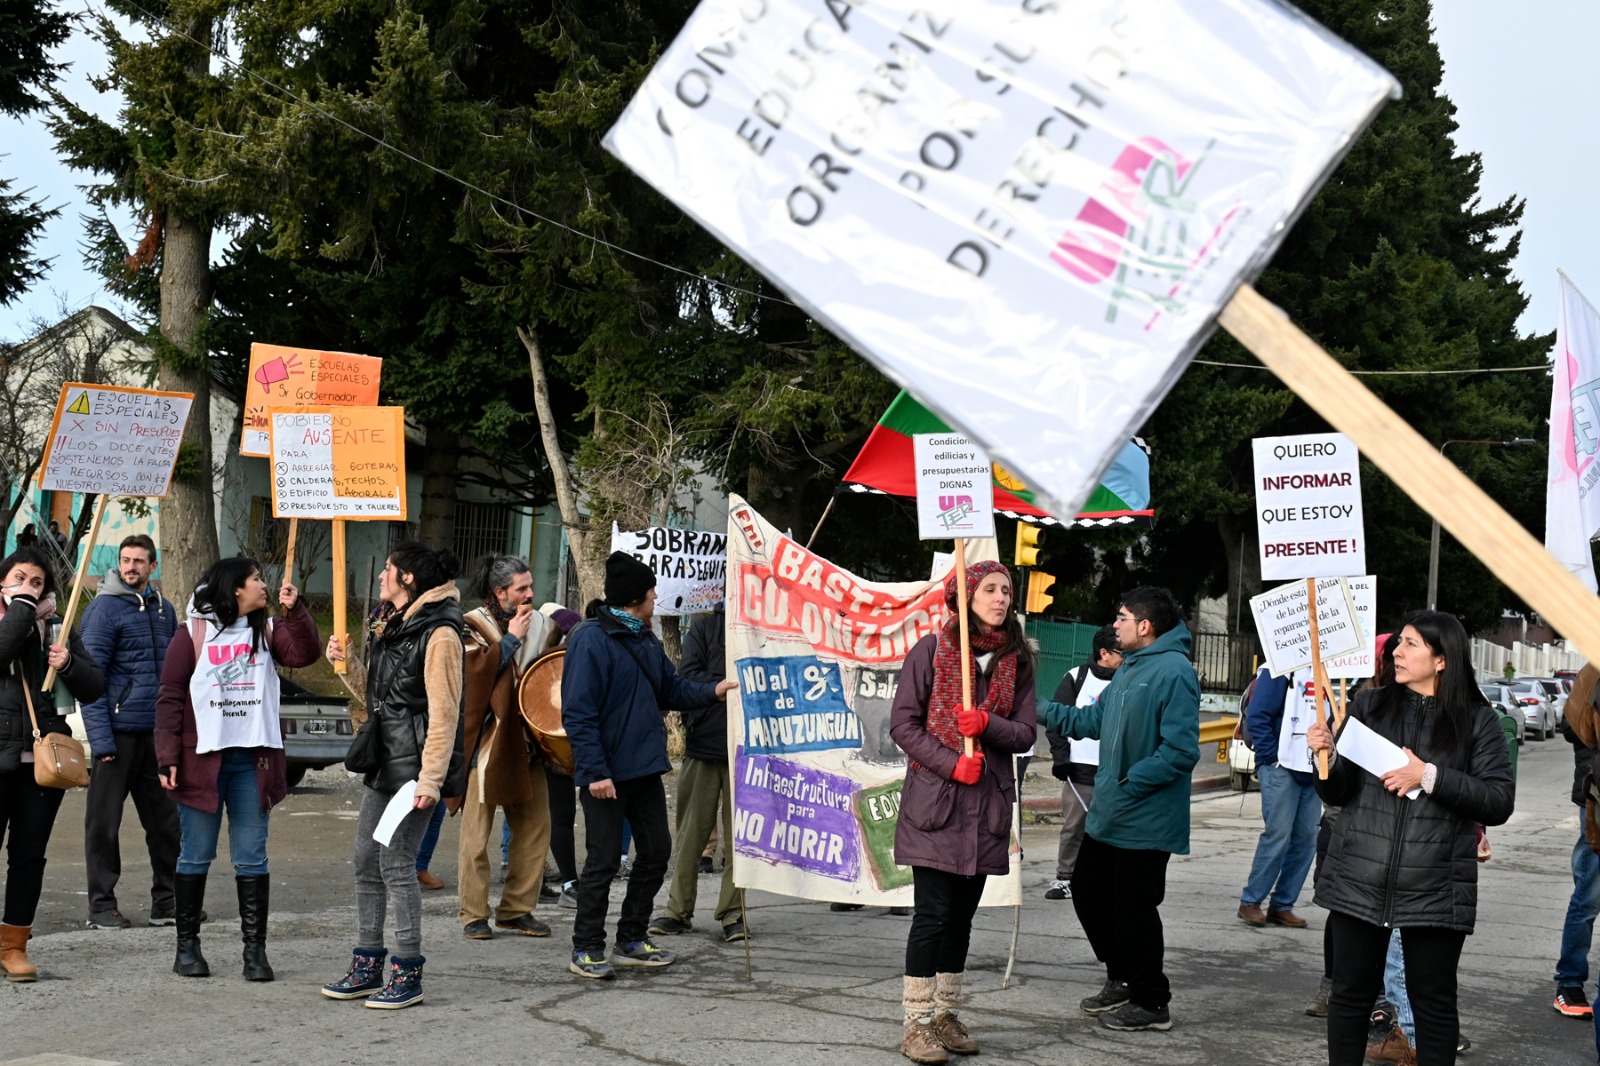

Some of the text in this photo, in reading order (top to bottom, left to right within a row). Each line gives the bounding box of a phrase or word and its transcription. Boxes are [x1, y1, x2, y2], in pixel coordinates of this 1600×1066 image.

[309, 359, 360, 373] ESCUELAS
[311, 370, 370, 386] ESPECIALES
[97, 391, 172, 411] ESCUELAS
[302, 427, 385, 446] AUSENTE
[109, 441, 175, 459] DOCENTES
[934, 451, 976, 461] edilicias y
[1273, 442, 1337, 461] QUIERO
[50, 454, 171, 467] SOSTENEMOS LA FALTA
[292, 463, 339, 472] ARREGLAR
[46, 466, 61, 476] DE
[70, 466, 129, 481] RECURSOS
[135, 472, 152, 482] CON
[922, 465, 989, 477] presupuestarias
[55, 479, 101, 491] NUESTRO
[939, 480, 973, 489] DIGNAS
[1262, 472, 1352, 491] INFORMAR
[290, 502, 348, 511] PRESUPUESTO
[354, 503, 363, 511] DE
[1261, 504, 1353, 524] QUE ESTOY
[1264, 539, 1348, 558] PRESENTE
[776, 543, 893, 618] BASTA
[1289, 586, 1307, 600] está
[1316, 578, 1340, 593] plata
[1275, 609, 1287, 620] de
[1287, 606, 1296, 617] la
[1316, 596, 1328, 607] de
[1318, 610, 1330, 621] de
[1329, 607, 1340, 617] la
[1274, 633, 1307, 651] Escuela
[742, 664, 788, 695] NO al
[774, 692, 795, 710] de
[222, 709, 247, 718] Docente
[748, 712, 859, 748] MAPUZUNGUN
[744, 757, 850, 813] Infraestructura
[787, 801, 815, 821] para
[734, 807, 764, 842] NO
